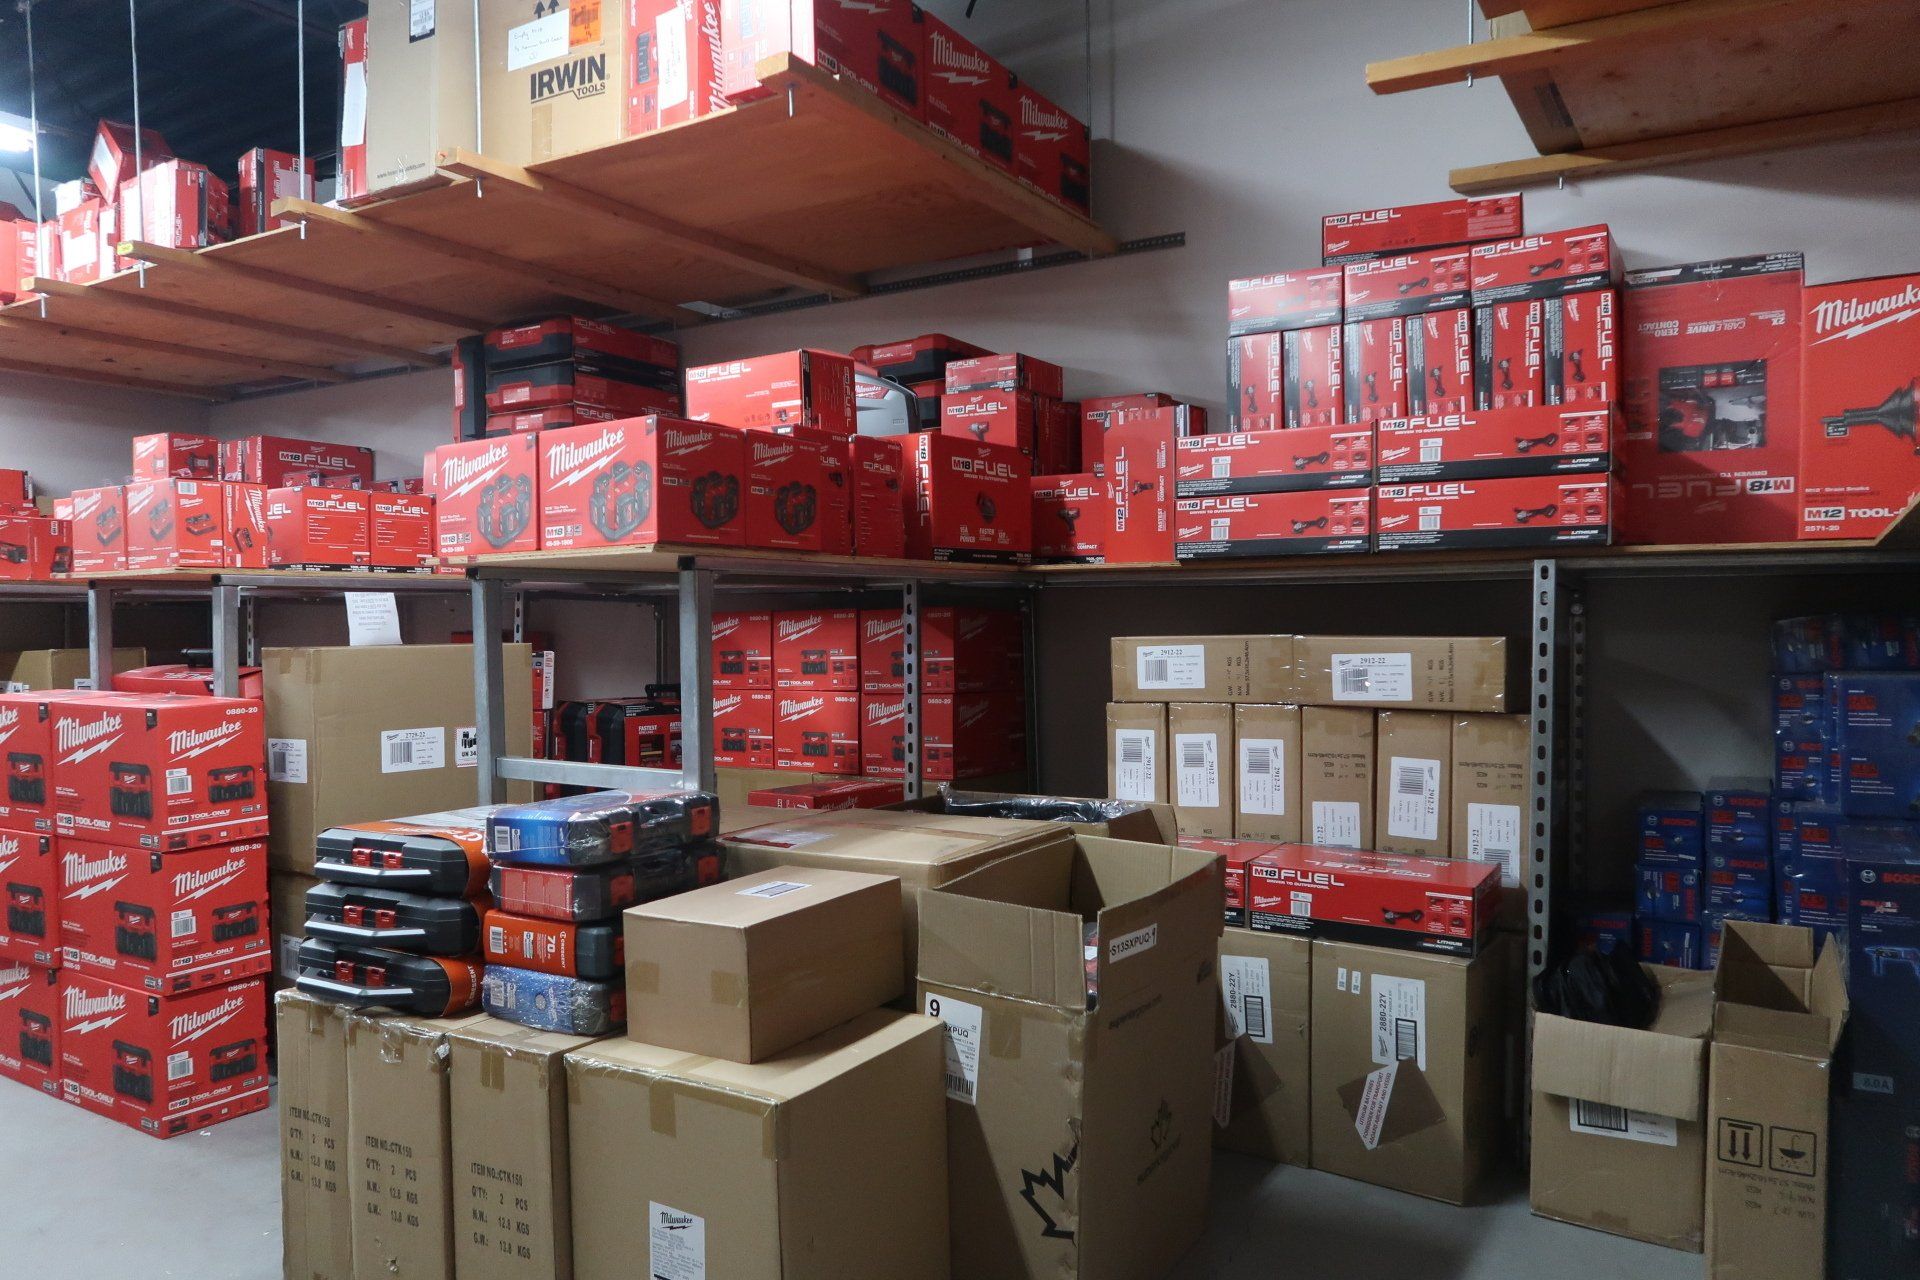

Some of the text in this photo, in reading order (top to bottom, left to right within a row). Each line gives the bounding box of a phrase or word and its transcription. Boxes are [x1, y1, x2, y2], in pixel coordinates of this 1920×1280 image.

[931, 30, 990, 73] Milwaukee
[530, 53, 606, 100] IRWIN
[840, 64, 879, 94] TOOL-ONLY
[577, 82, 606, 97] TOOLS
[1019, 95, 1069, 130] Milwaukee
[1327, 209, 1402, 225] M18 FUEL
[1474, 236, 1553, 256] M18 FUEL
[1369, 256, 1420, 271] FUEL
[1251, 273, 1297, 287] FUEL
[1807, 284, 1920, 335] Milwauk
[1529, 303, 1540, 379] M18 FUEL
[1601, 294, 1612, 371] M18 FUEL
[1654, 327, 1680, 337] ZERO
[1459, 312, 1470, 385] M18 FUEL
[707, 362, 752, 378] FUEL
[957, 359, 981, 367] FUEL
[1393, 342, 1403, 392] FUEL
[1270, 356, 1280, 403] FUEL
[1331, 349, 1341, 397] FUEL
[947, 402, 1008, 415] M18 FUEL
[1382, 415, 1477, 430] M18 FUEL
[664, 428, 713, 449] Milwaukee
[1179, 434, 1260, 448] M18 FUEL
[281, 452, 356, 468] M18 FUEL
[546, 427, 625, 480] Milwaukee
[752, 442, 794, 461] Milwaukee
[440, 443, 509, 490] Milwaukee
[952, 457, 1018, 478] M18 FUEL
[1116, 446, 1125, 505] FUEL
[919, 435, 931, 527] M18 FUEL
[1381, 483, 1476, 497] M18 FUEL
[1633, 478, 1793, 499] M18 FUEL
[1035, 486, 1100, 498] M18 FUEL
[248, 487, 266, 533] Milwaukee
[326, 501, 366, 511] FUEL
[393, 506, 429, 515] FUEL
[1178, 497, 1259, 510] M18 FUEL
[1807, 508, 1844, 519] M12
[442, 535, 456, 544] M18
[546, 527, 564, 538] M18
[777, 614, 822, 637] Milwaukee
[779, 695, 824, 716] Milwaukee
[54, 711, 123, 752] Milwaukee
[166, 720, 243, 755] Milwaukee
[57, 814, 112, 828] M18 TOOL-ONLY
[168, 808, 231, 825] M18 TOOL-ONLY
[61, 850, 128, 887] Milwaukee
[170, 857, 247, 897] Milwaukee
[1253, 868, 1345, 887] M18 FUEL
[1253, 895, 1282, 905] Milwaukee
[547, 935, 556, 953] 70
[1437, 939, 1463, 947] LITHIUM
[64, 949, 117, 967] M18 TOOL-ONLY
[172, 945, 235, 967] M18 TOOL-ONLY
[1229, 972, 1237, 1009] 2880-22Y
[63, 985, 126, 1020] Milwaukee
[930, 998, 941, 1018] 9
[1379, 992, 1387, 1032] 2880-22Y
[168, 995, 244, 1040] Milwaukee
[64, 1080, 115, 1105] M18 TOOL-ONLY
[1373, 1072, 1384, 1100] TRANSPORT
[169, 1084, 232, 1110] M18 TOOL-ONLY
[289, 1106, 302, 1119] ITEM
[324, 1137, 335, 1150] PCS
[366, 1135, 379, 1149] ITEM
[324, 1159, 336, 1172] KGS
[405, 1168, 417, 1182] PCS
[470, 1162, 486, 1175] ITEM
[325, 1181, 336, 1193] KGS
[406, 1191, 418, 1205] KGS
[515, 1197, 528, 1212] PCS
[407, 1214, 419, 1228] KGS
[498, 1215, 512, 1231] 12.8
[516, 1221, 530, 1236] KGS
[660, 1211, 693, 1225] Milwaukee
[473, 1231, 531, 1260] G.W.: KGS
